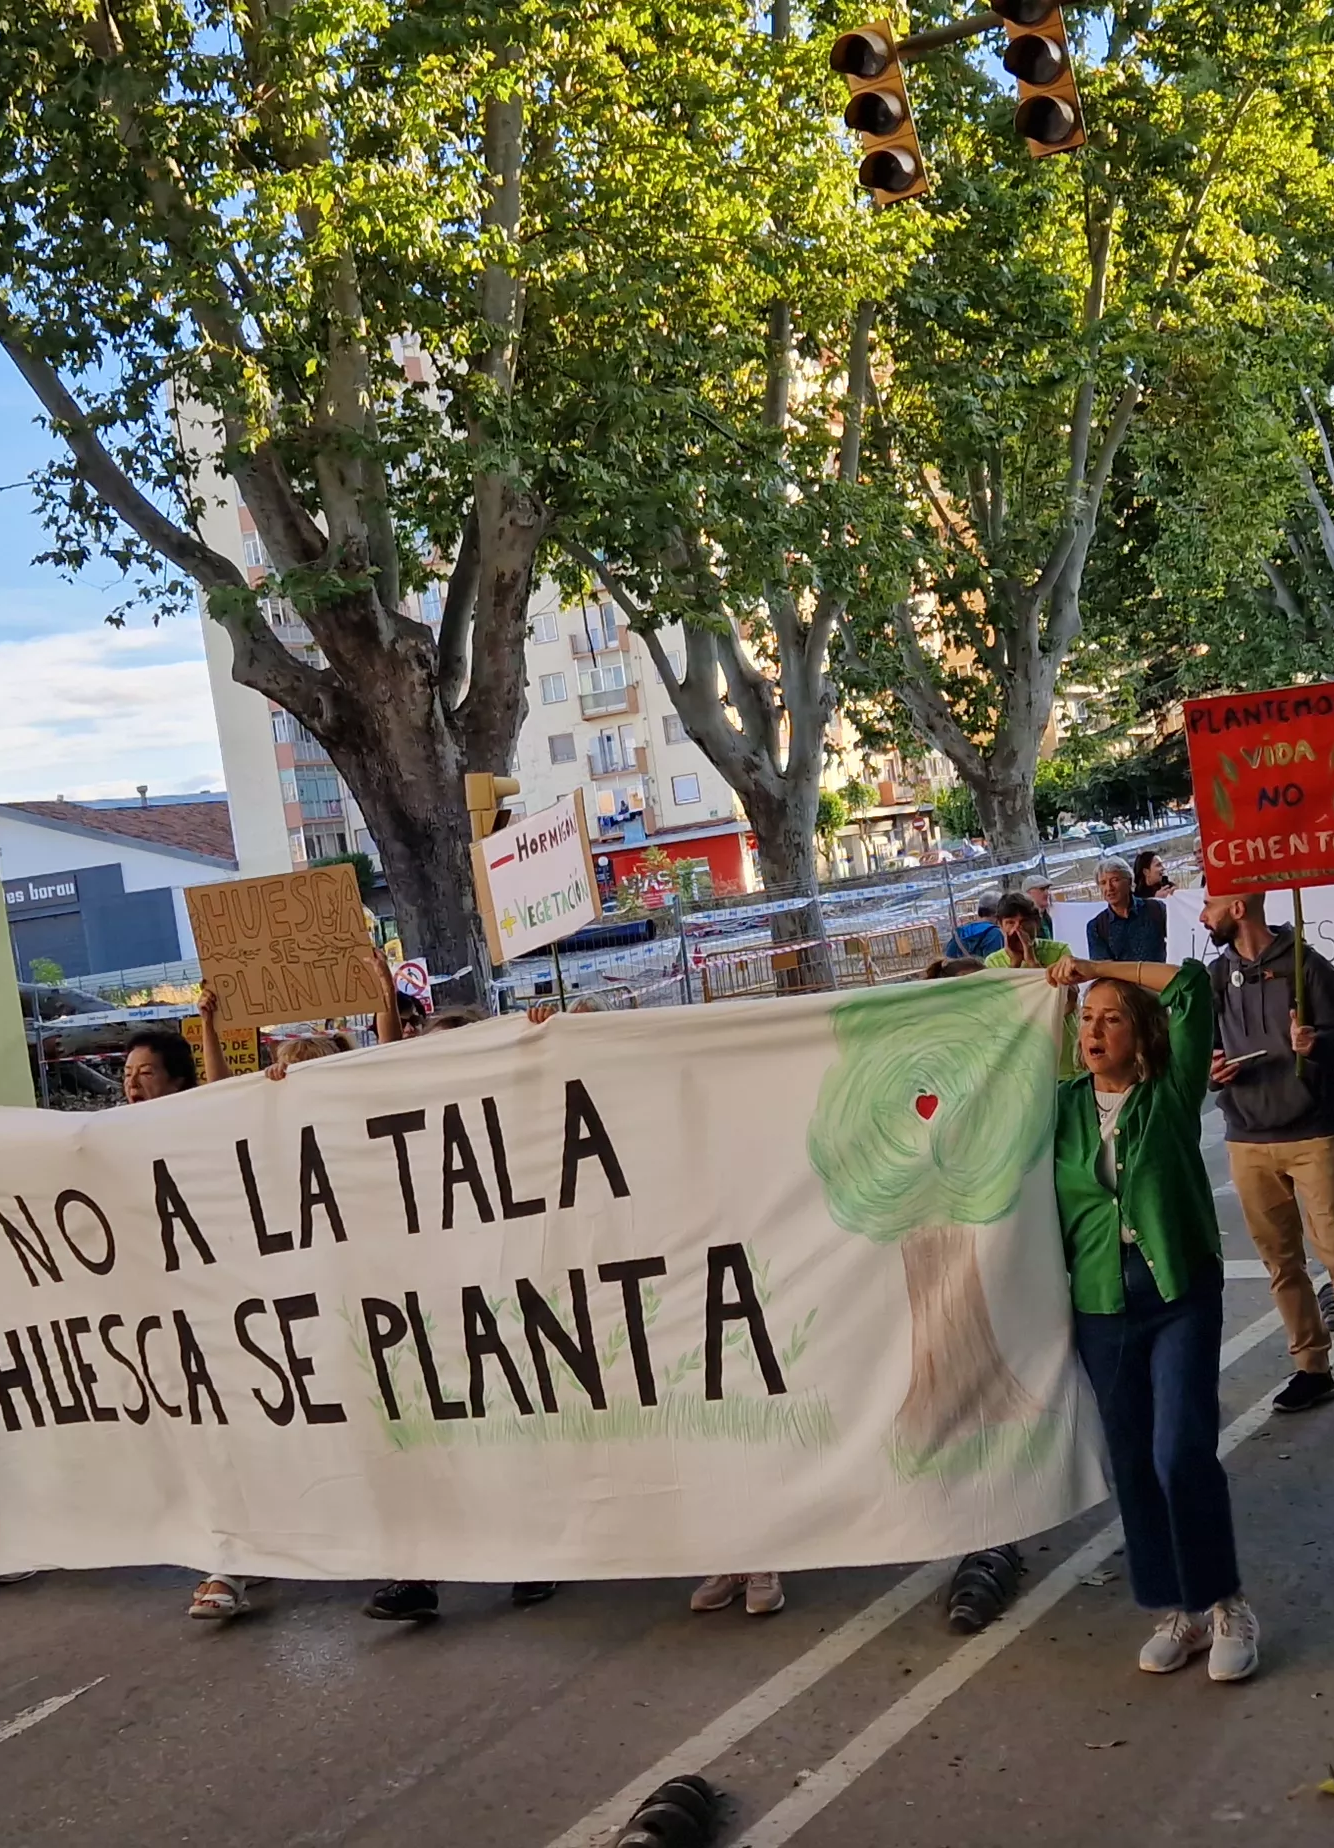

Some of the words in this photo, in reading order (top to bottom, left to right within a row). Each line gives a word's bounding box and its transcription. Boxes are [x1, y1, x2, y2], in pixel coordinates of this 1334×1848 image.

[1257, 783, 1305, 812] NO
[28, 882, 76, 900] borau
[201, 871, 367, 947] HUESCA
[514, 867, 589, 931] VEGETACIÓN
[269, 939, 301, 964] SE
[213, 955, 378, 1021] PLANTA
[232, 1040, 249, 1051] DE
[152, 1158, 216, 1273] A
[235, 1125, 349, 1256] LA
[366, 1079, 630, 1237] TALA
[233, 1293, 349, 1428] SE
[360, 1241, 787, 1421] PLANTA
